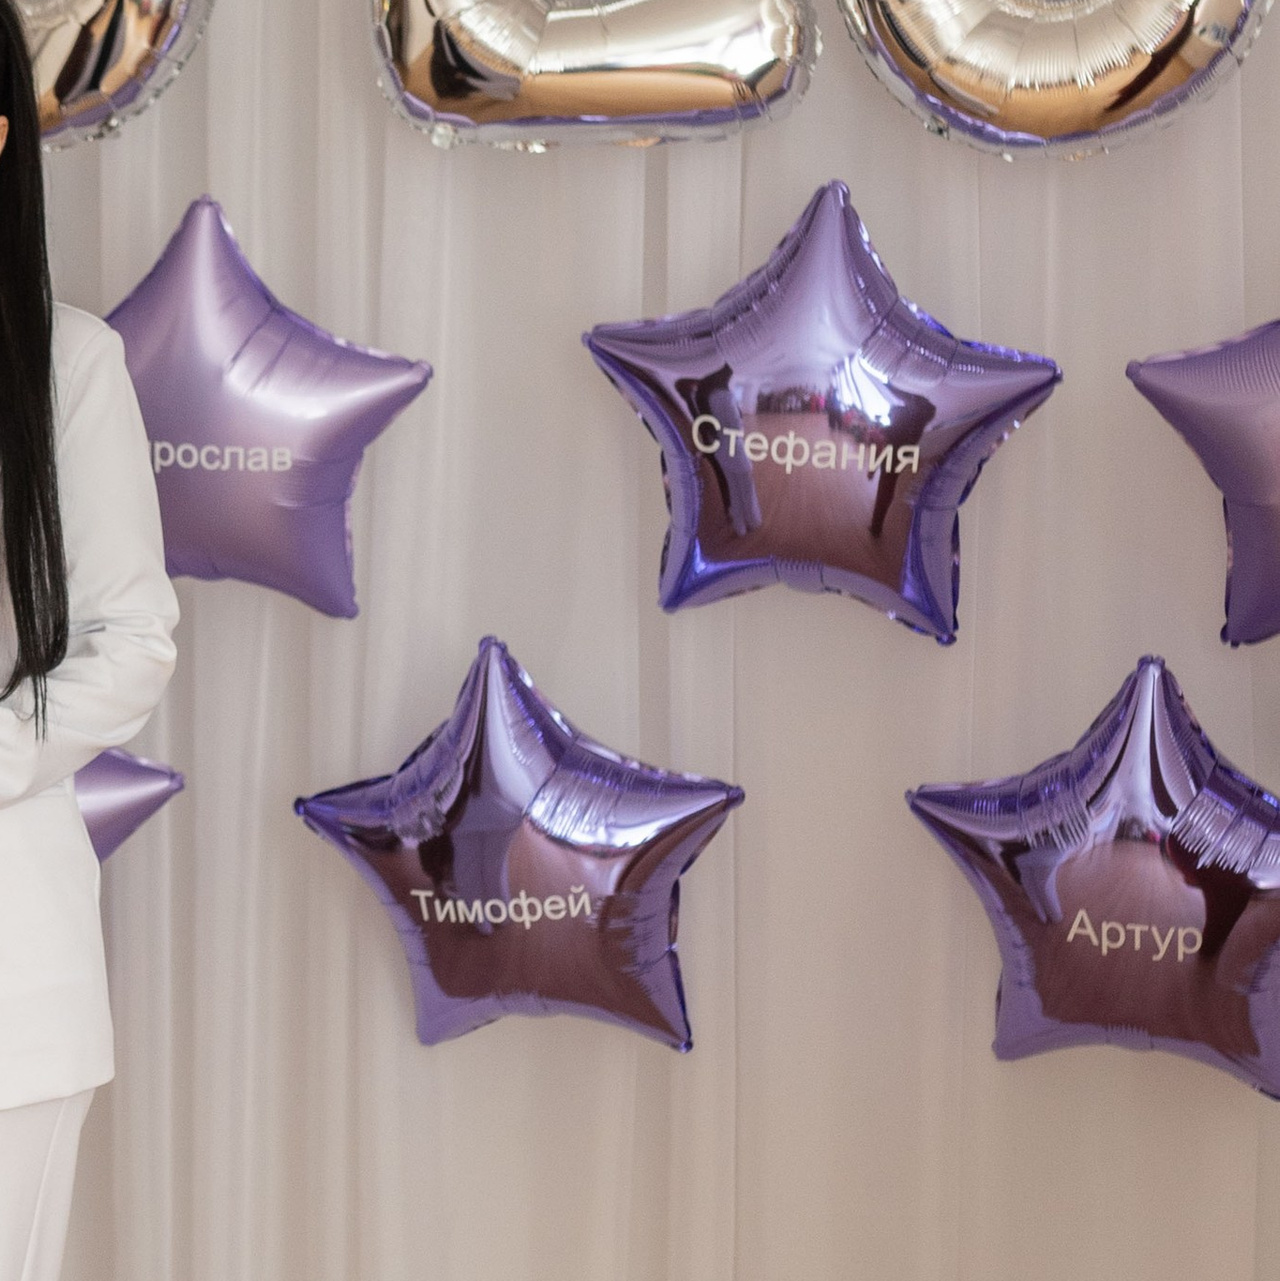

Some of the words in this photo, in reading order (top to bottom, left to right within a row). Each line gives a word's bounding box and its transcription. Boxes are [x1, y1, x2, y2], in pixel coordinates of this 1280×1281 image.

[148, 437, 294, 474] рослав
[691, 413, 920, 475] Стефания
[410, 884, 592, 930] Тимофей
[1066, 908, 1203, 962] Артур
